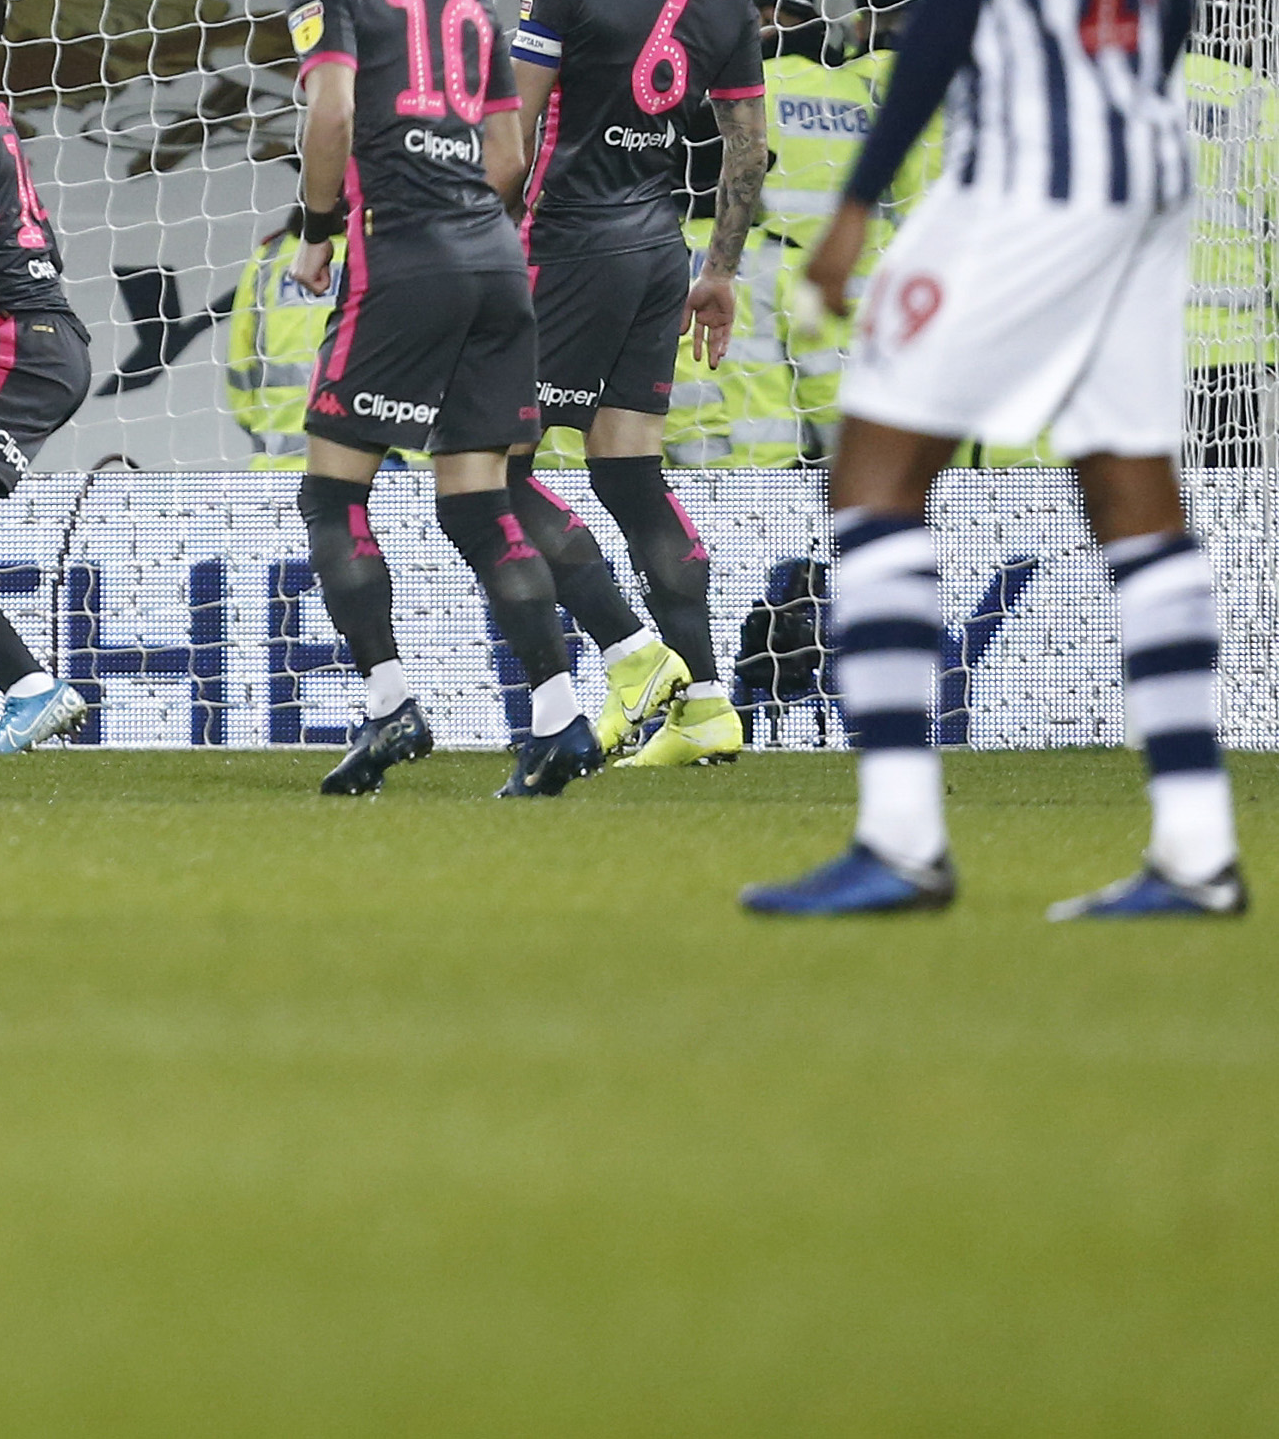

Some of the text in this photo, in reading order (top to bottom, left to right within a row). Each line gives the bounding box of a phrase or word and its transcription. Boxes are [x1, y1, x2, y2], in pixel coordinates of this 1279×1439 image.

[780, 99, 871, 135] POLICE
[404, 127, 471, 160] Clipper
[604, 125, 667, 152] Clipper
[352, 391, 440, 425] Clipper
